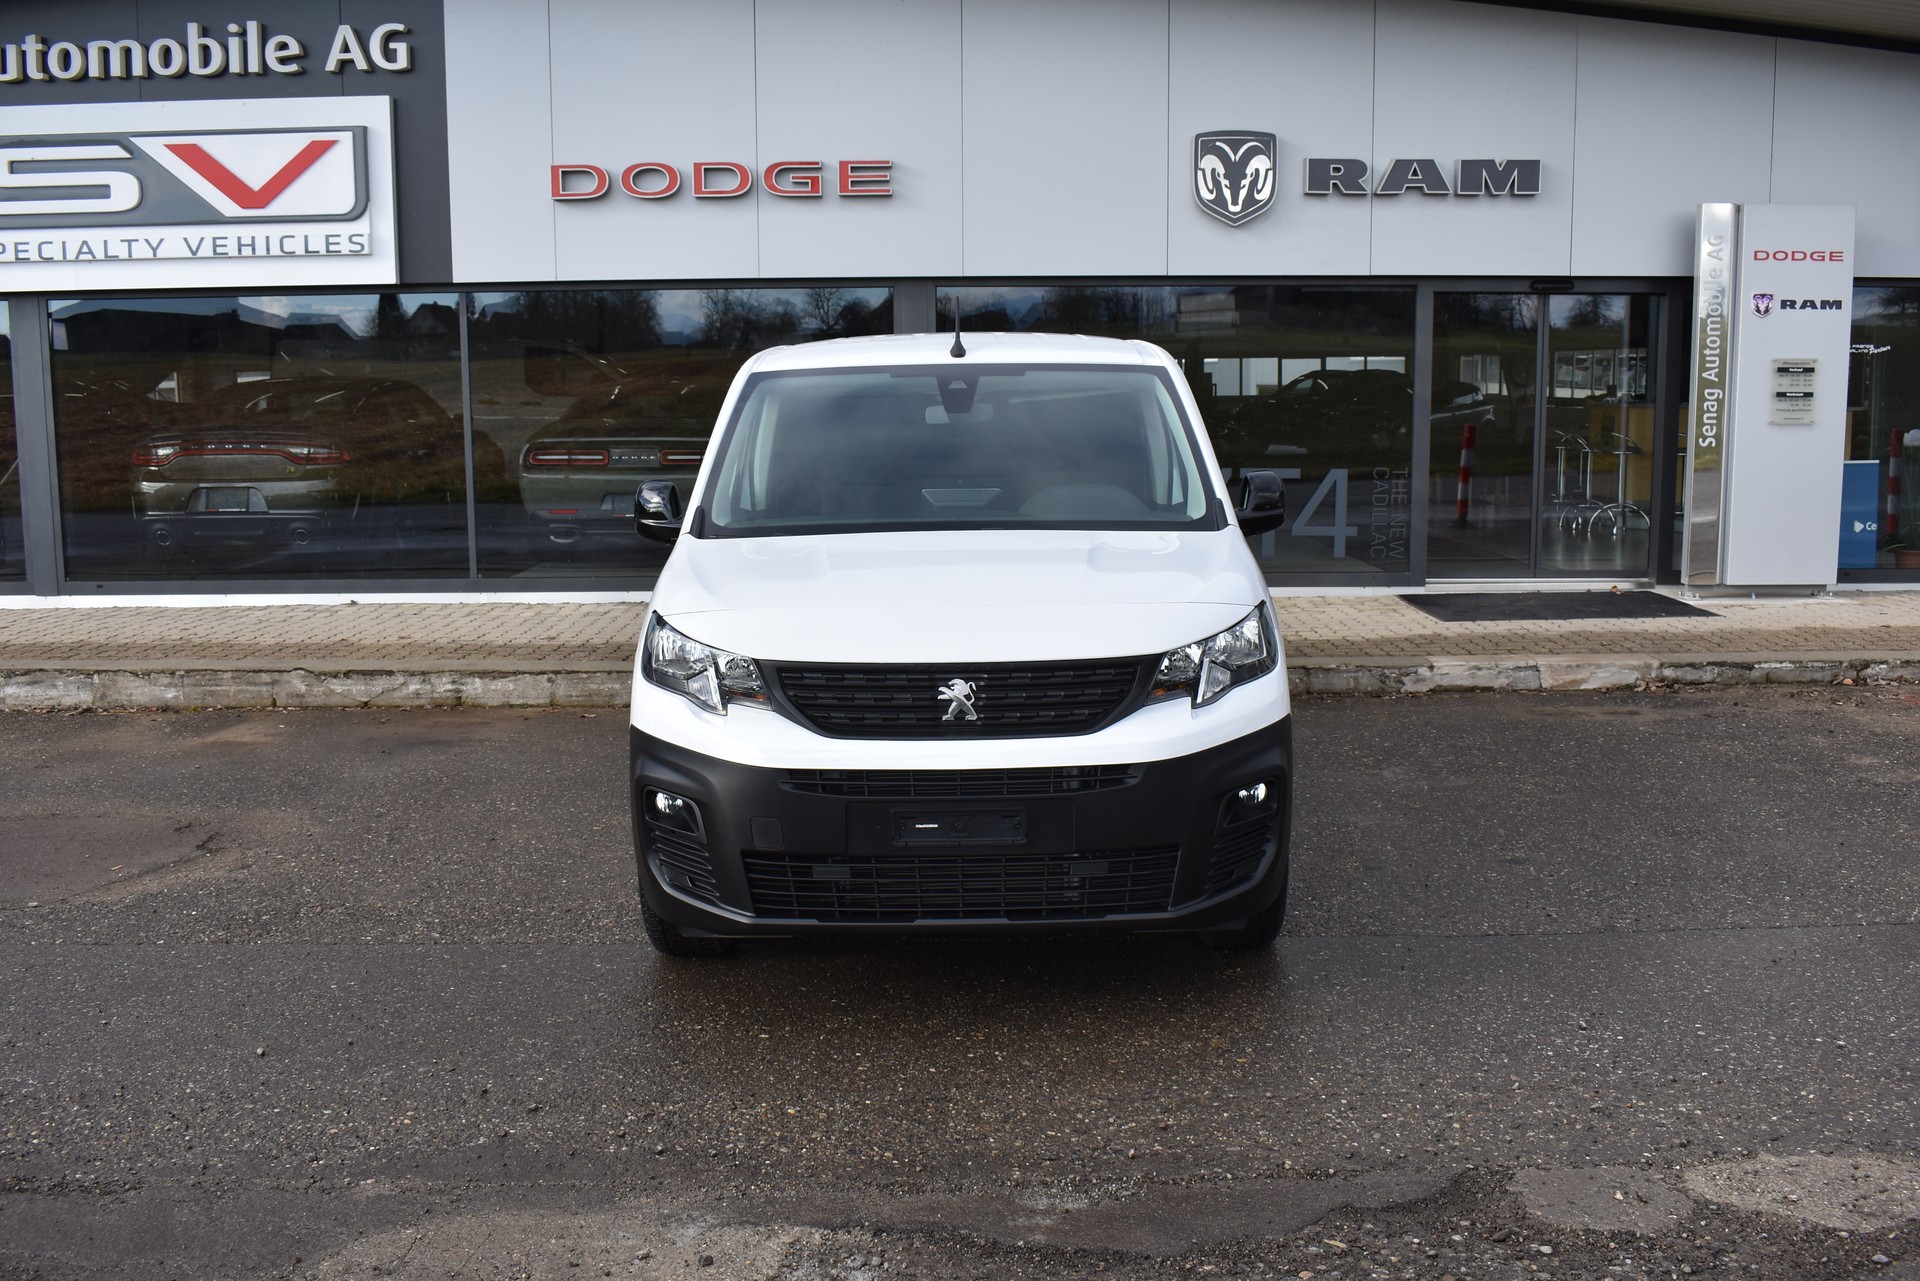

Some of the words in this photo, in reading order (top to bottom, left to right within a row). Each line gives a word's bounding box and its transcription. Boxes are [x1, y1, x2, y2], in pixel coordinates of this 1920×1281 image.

[325, 23, 411, 73] AG
[550, 160, 893, 200] DODGE
[1304, 157, 1542, 196] RAM
[183, 234, 366, 256] VEHICLES
[1707, 234, 1725, 261] AG
[1753, 250, 1844, 262] DODGE
[1701, 267, 1724, 382] Automobile
[1780, 299, 1842, 310] RAM
[1699, 388, 1723, 447] Senag
[1391, 467, 1408, 505] THE
[1222, 468, 1358, 558] T4
[1370, 467, 1390, 558] CADILLAC
[1389, 513, 1406, 558] NEW
